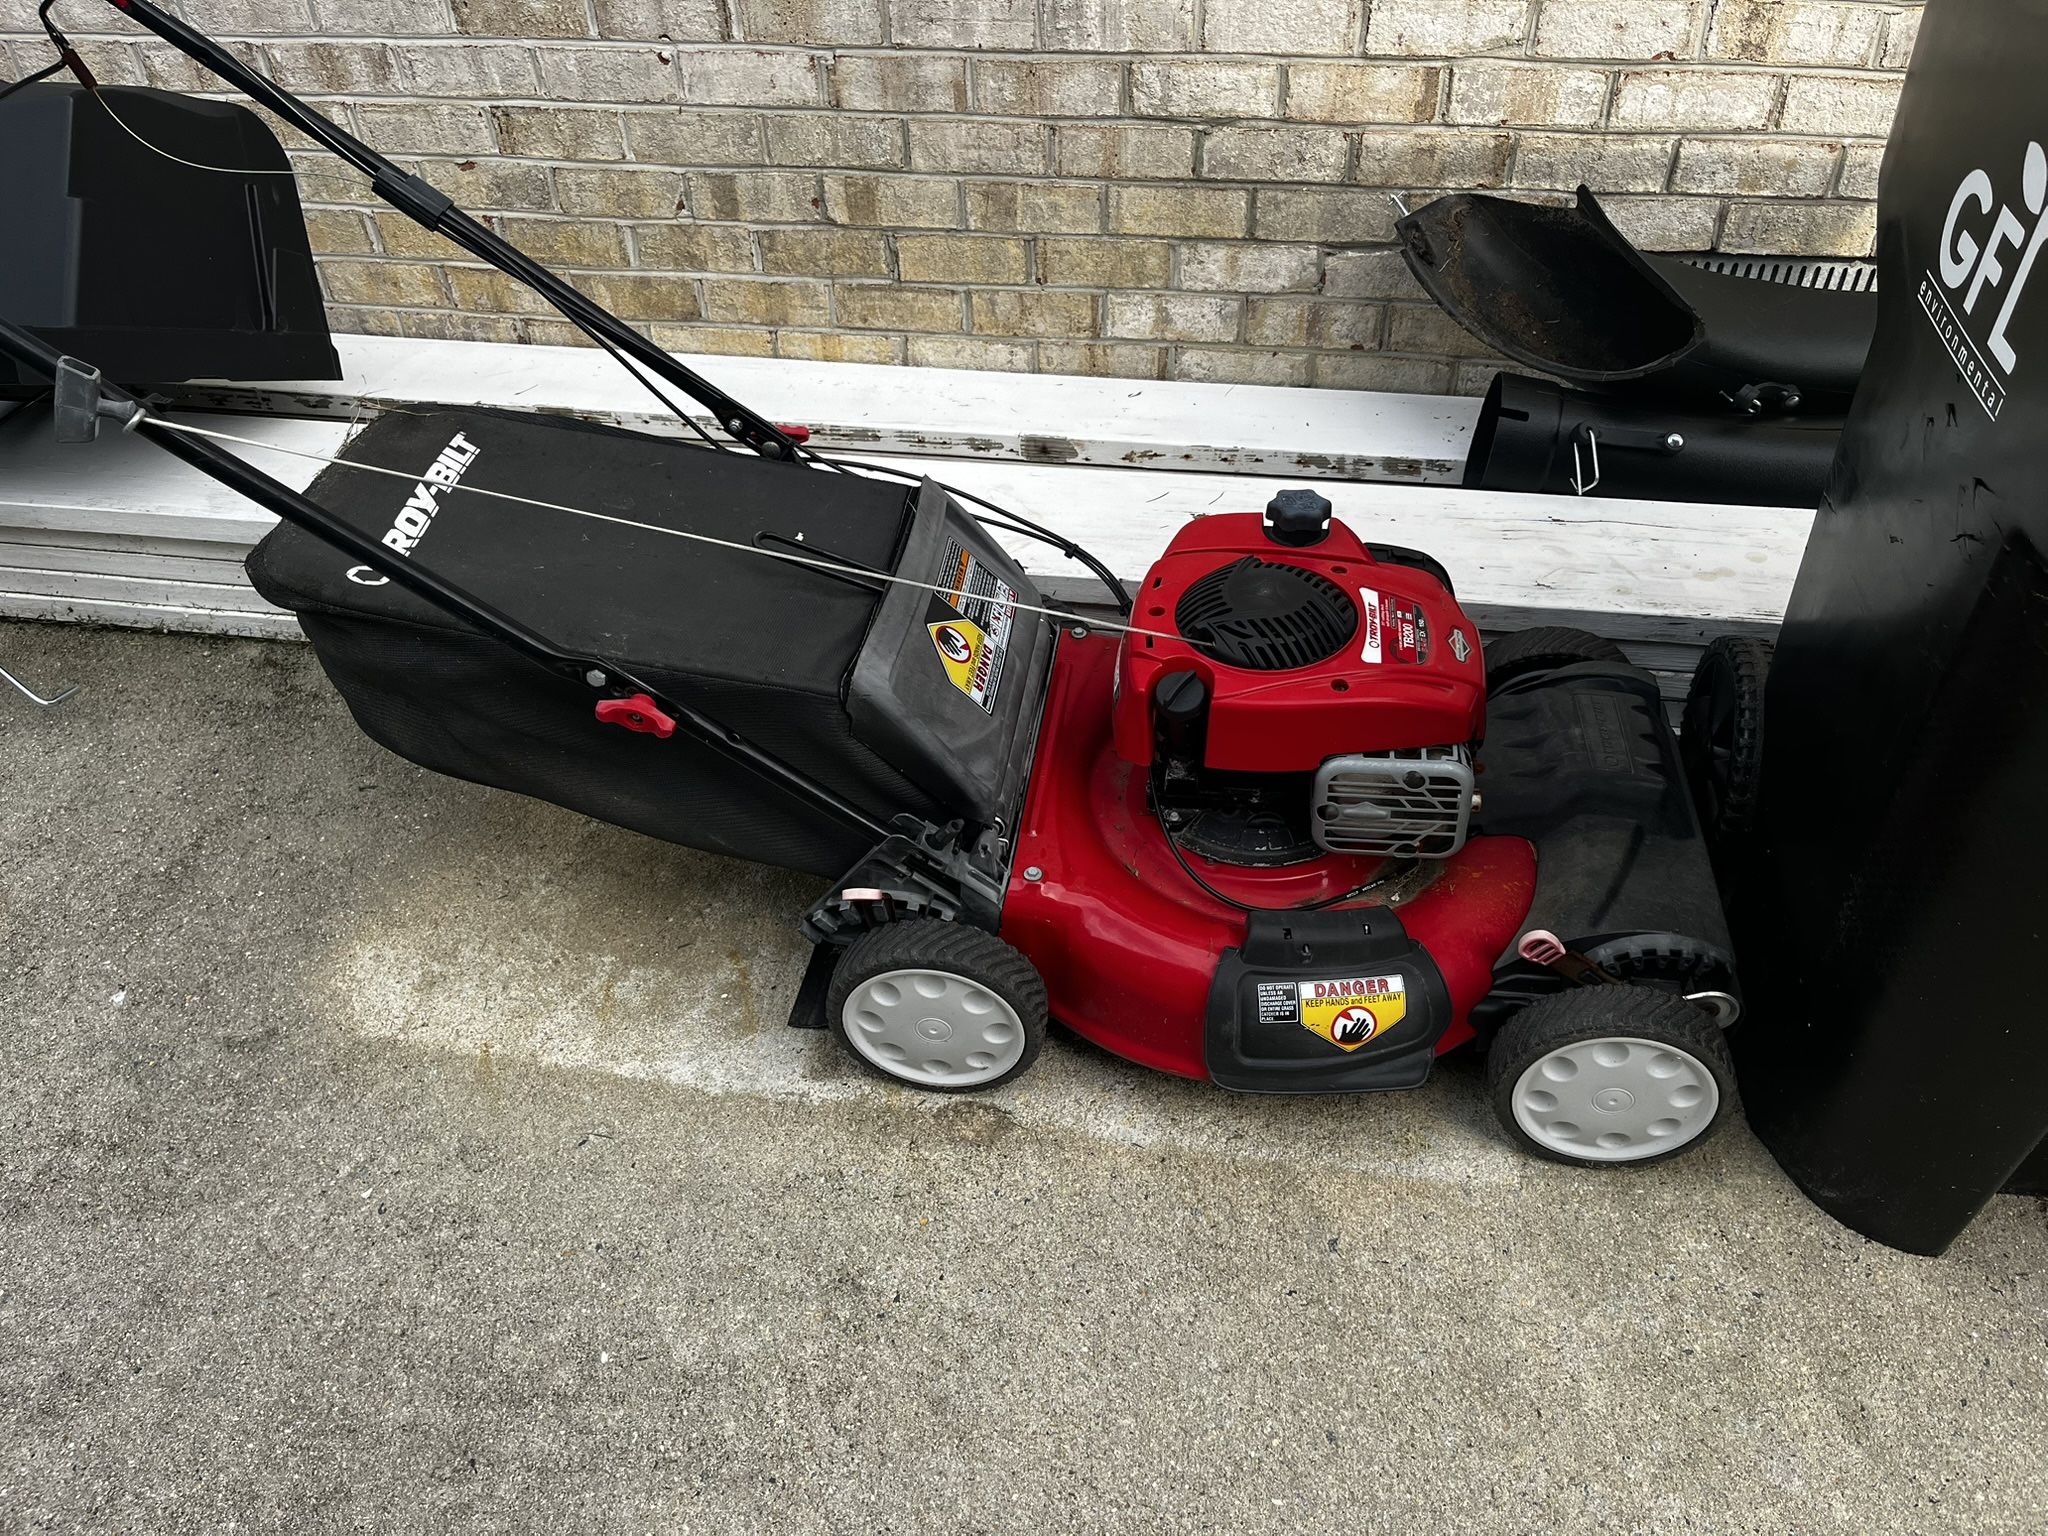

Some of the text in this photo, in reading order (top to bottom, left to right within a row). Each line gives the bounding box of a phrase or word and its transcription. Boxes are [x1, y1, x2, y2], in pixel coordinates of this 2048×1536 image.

[1939, 168, 2048, 376] GFL
[1919, 279, 2004, 417] environmental
[380, 431, 481, 558] ROY-BILT
[1368, 601, 1378, 641] TROY-BILT
[1402, 623, 1414, 648] TB200
[973, 643, 992, 693] DANGER
[1305, 992, 1401, 1008] KEEP HANDS and FEET AWAY
[1314, 978, 1390, 998] DANGER
